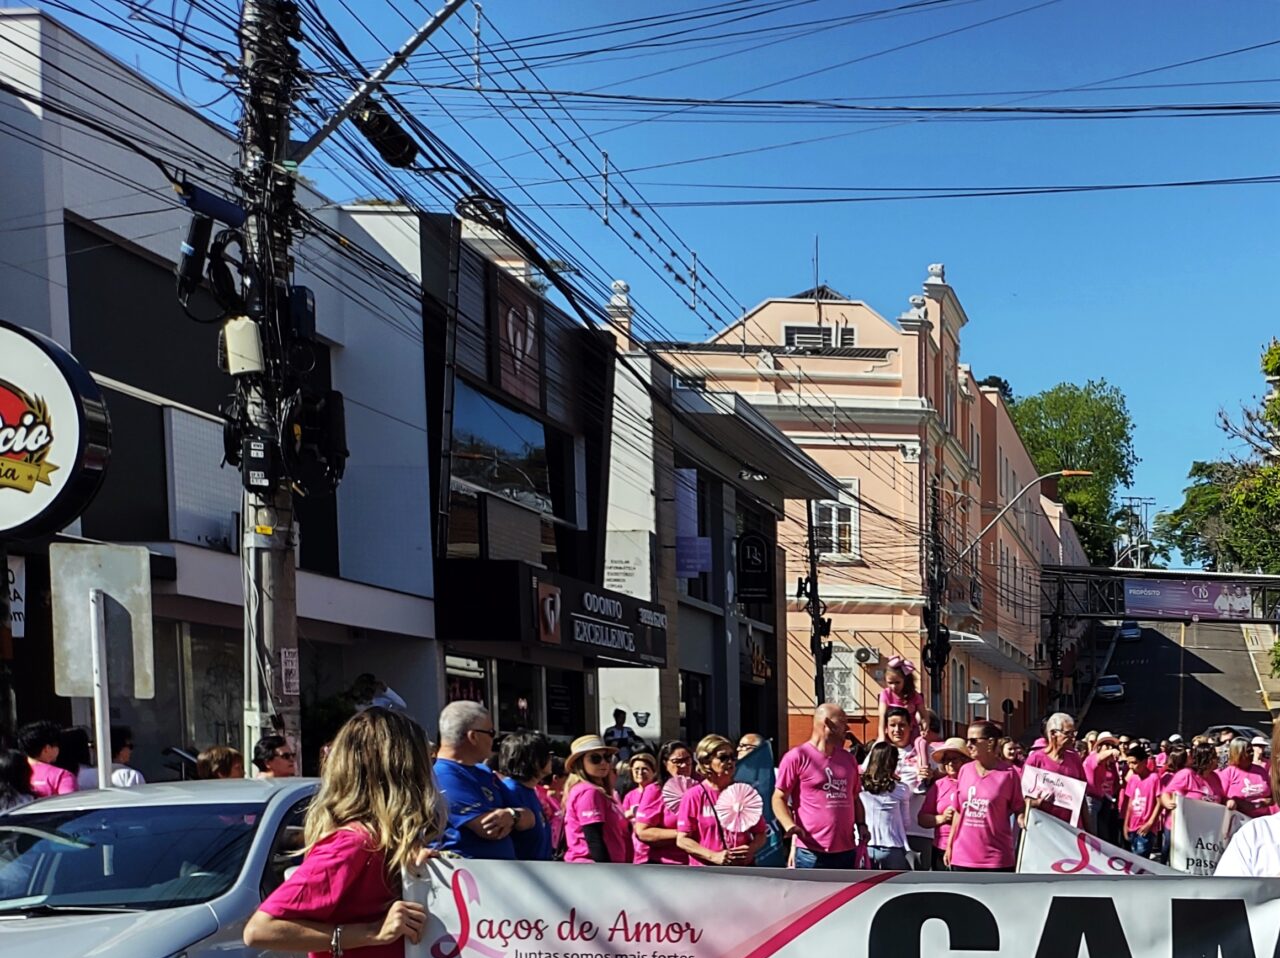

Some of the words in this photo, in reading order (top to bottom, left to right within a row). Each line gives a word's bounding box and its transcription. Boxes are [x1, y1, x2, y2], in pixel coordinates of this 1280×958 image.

[0, 413, 50, 453] cio
[583, 591, 623, 619] ODONTO
[573, 619, 636, 652] EXCELLENCE
[557, 907, 599, 942] de
[608, 909, 703, 945] Amor
